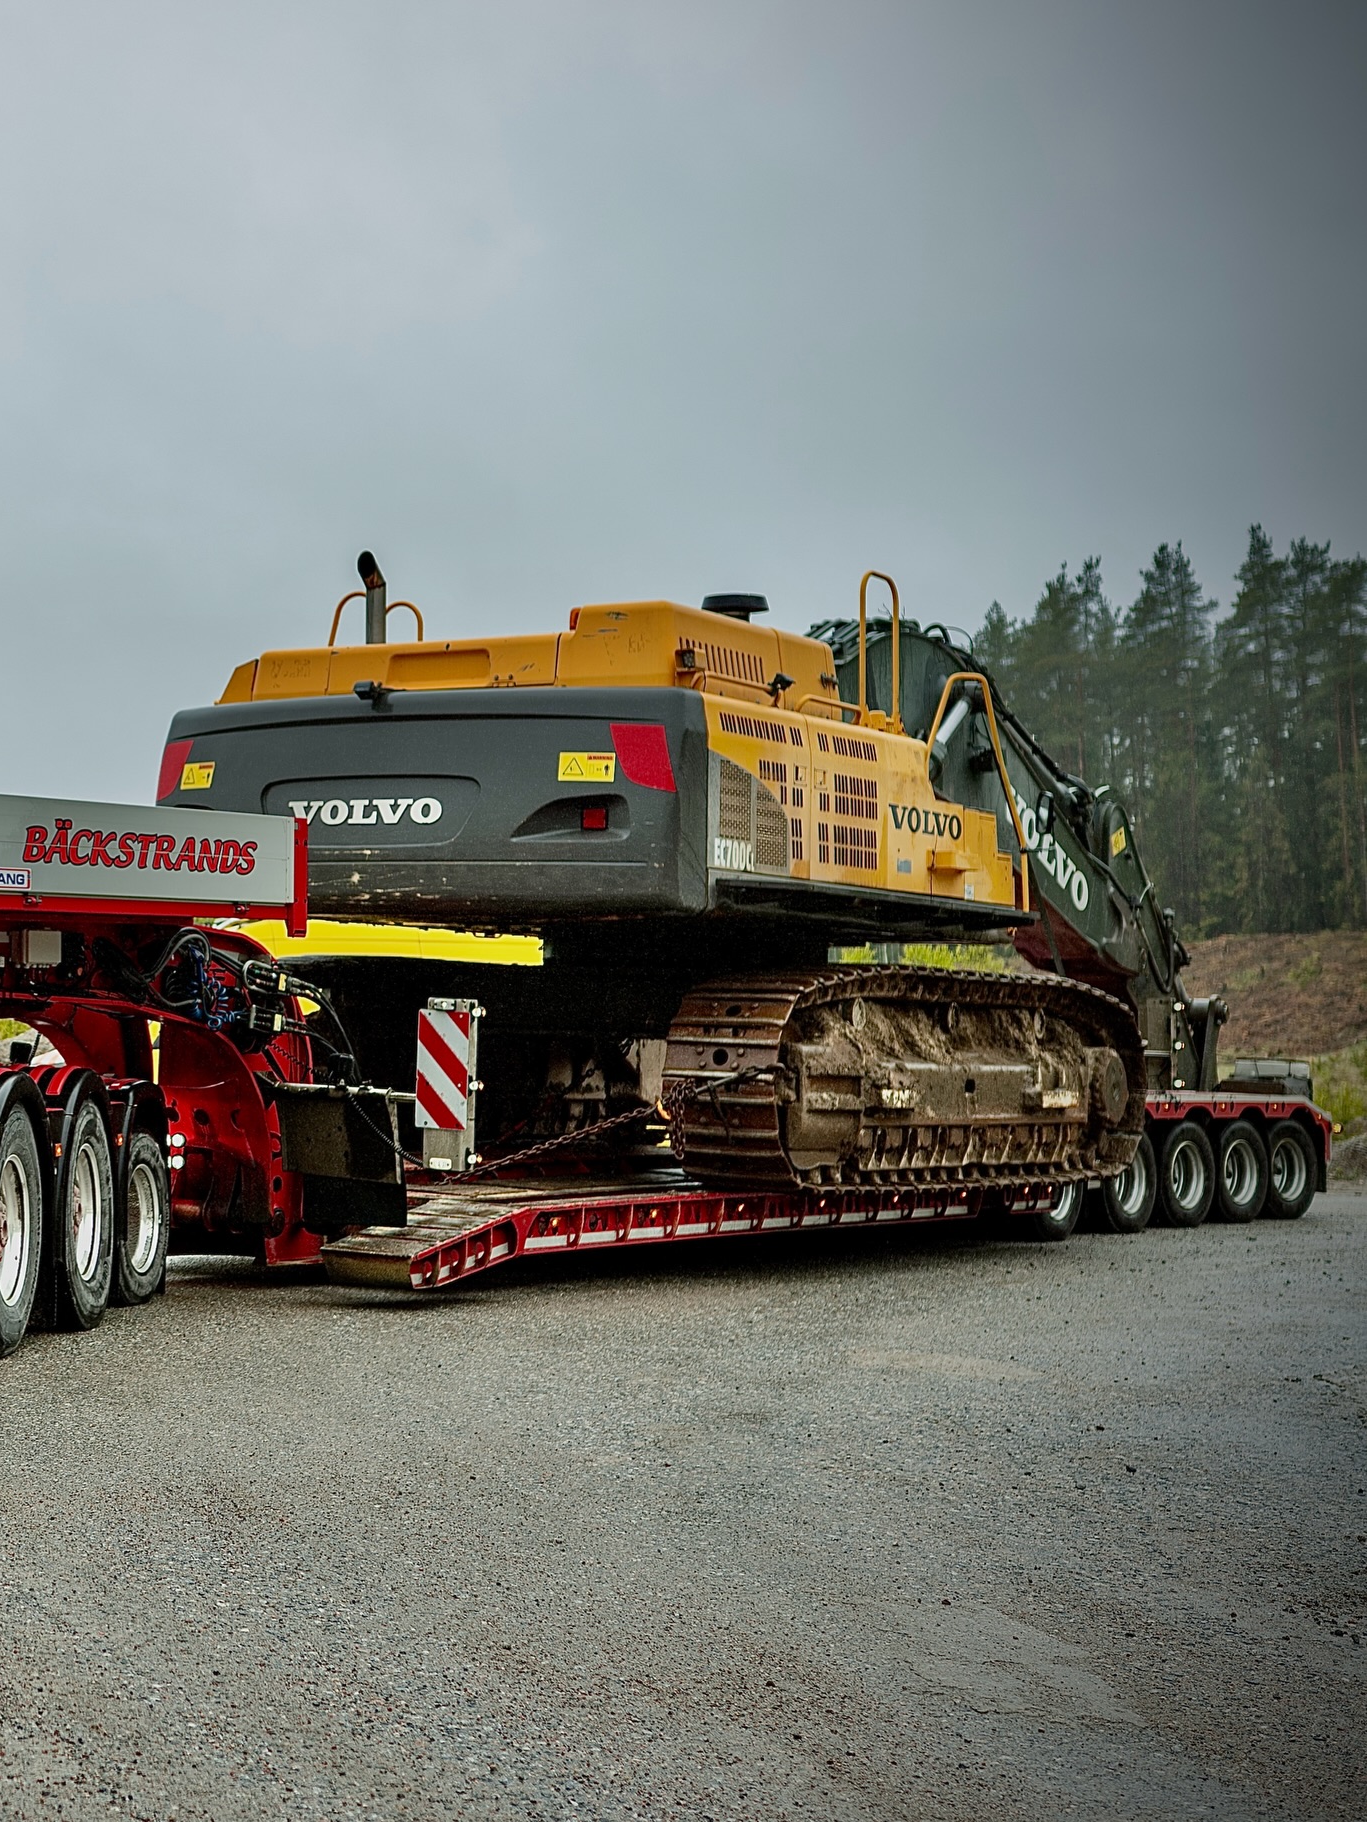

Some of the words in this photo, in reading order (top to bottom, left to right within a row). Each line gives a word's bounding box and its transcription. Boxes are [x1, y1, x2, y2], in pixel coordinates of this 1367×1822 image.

[288, 797, 443, 826] VOLVO
[888, 803, 962, 841] VOLVO
[22, 818, 258, 875] BÄCKSTRANDS
